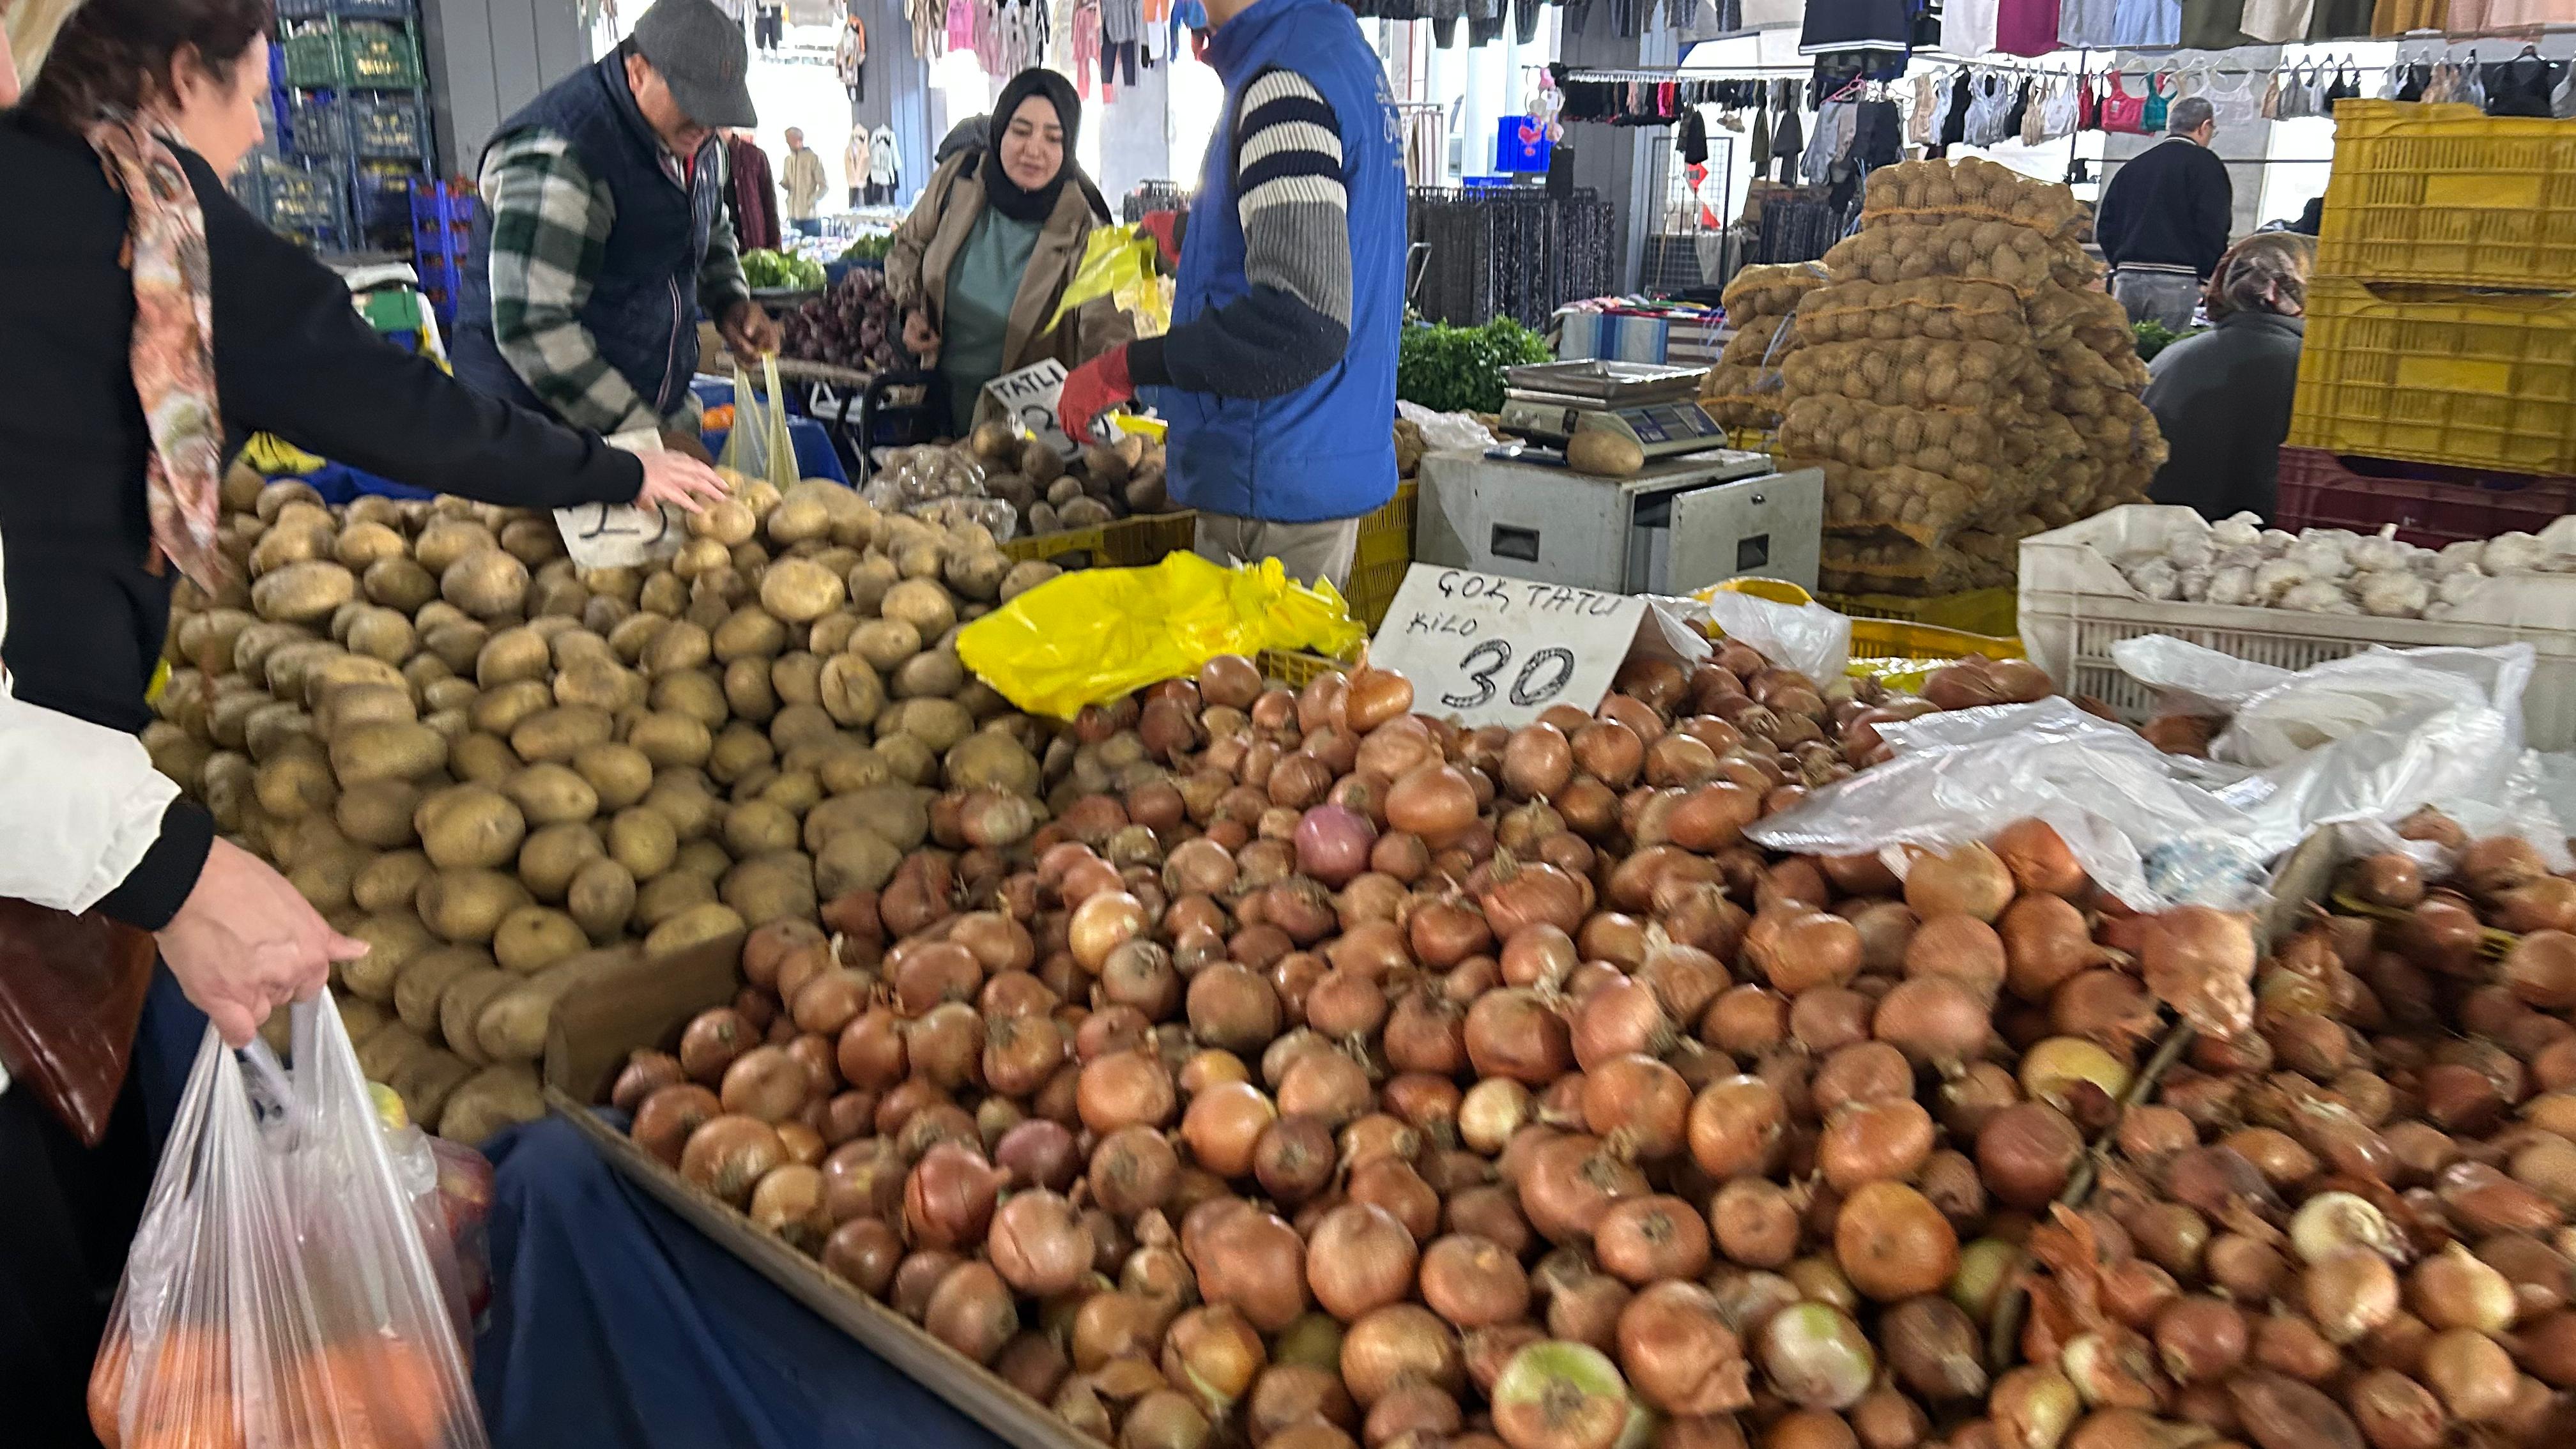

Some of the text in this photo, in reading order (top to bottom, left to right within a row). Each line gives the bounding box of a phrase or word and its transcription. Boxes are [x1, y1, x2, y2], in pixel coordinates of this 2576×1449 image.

[992, 364, 1065, 399] TATLI
[1438, 570, 1510, 614] ÇOK
[1441, 638, 1575, 708] 30
